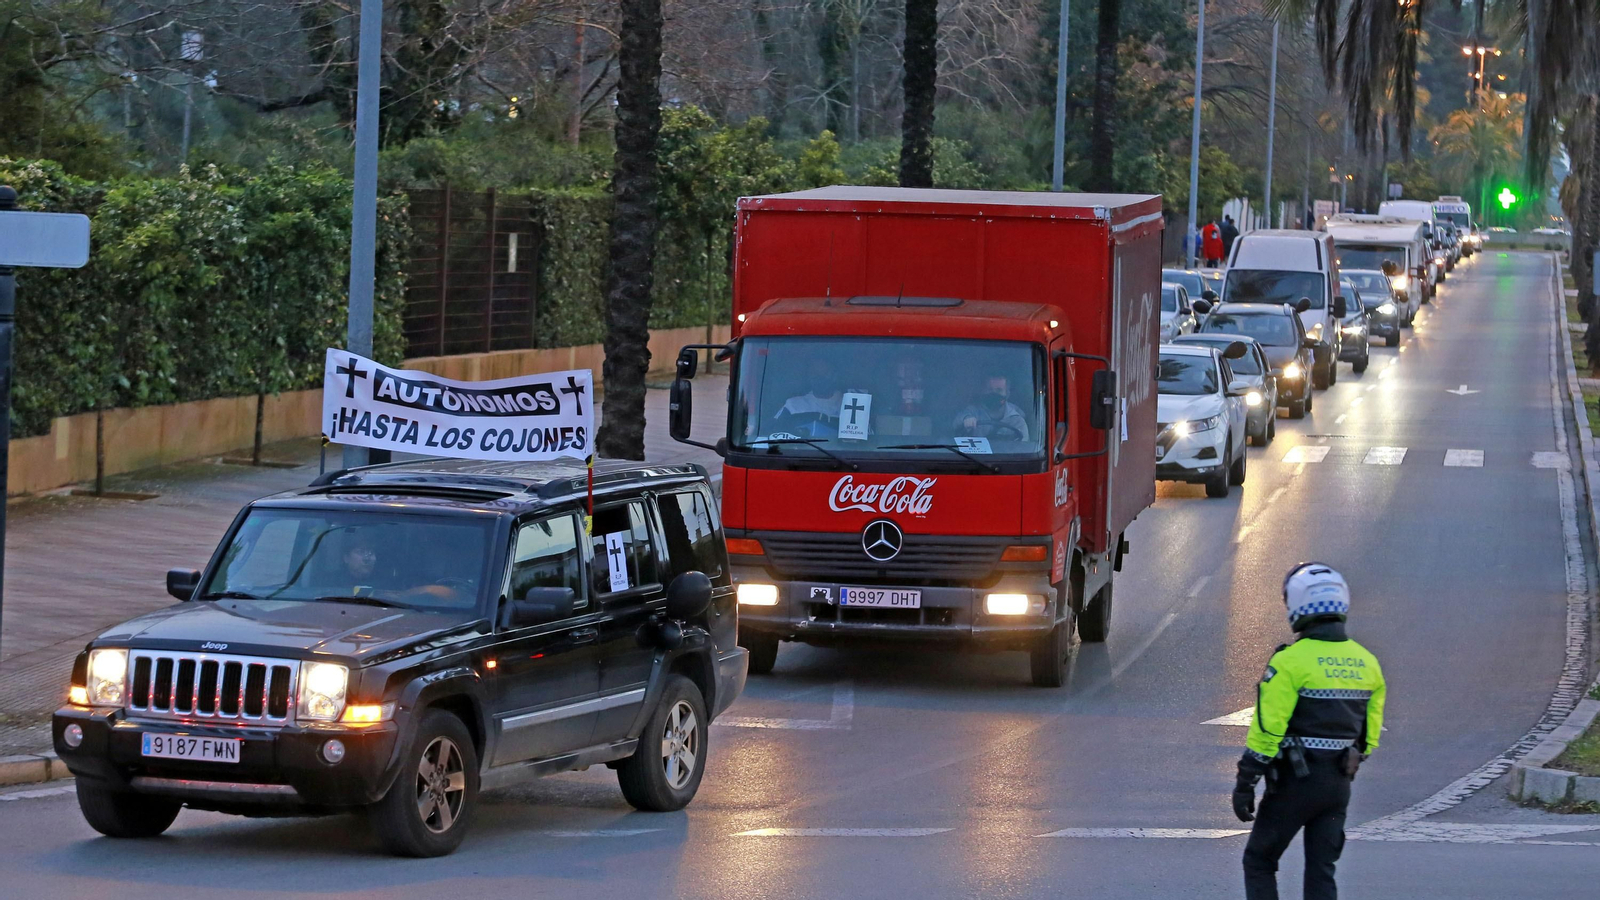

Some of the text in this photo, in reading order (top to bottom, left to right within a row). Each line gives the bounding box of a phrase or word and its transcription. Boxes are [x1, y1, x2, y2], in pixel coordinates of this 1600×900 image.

[331, 406, 419, 445] ¡HASTA
[425, 424, 476, 450] LOS
[828, 474, 938, 514] Coca-Cola
[848, 590, 918, 606] 9997 DHT
[201, 641, 228, 651] Jeep
[1317, 656, 1366, 668] POLICIA
[1324, 668, 1363, 680] LOCAL
[153, 736, 235, 759] 9187 FMN
